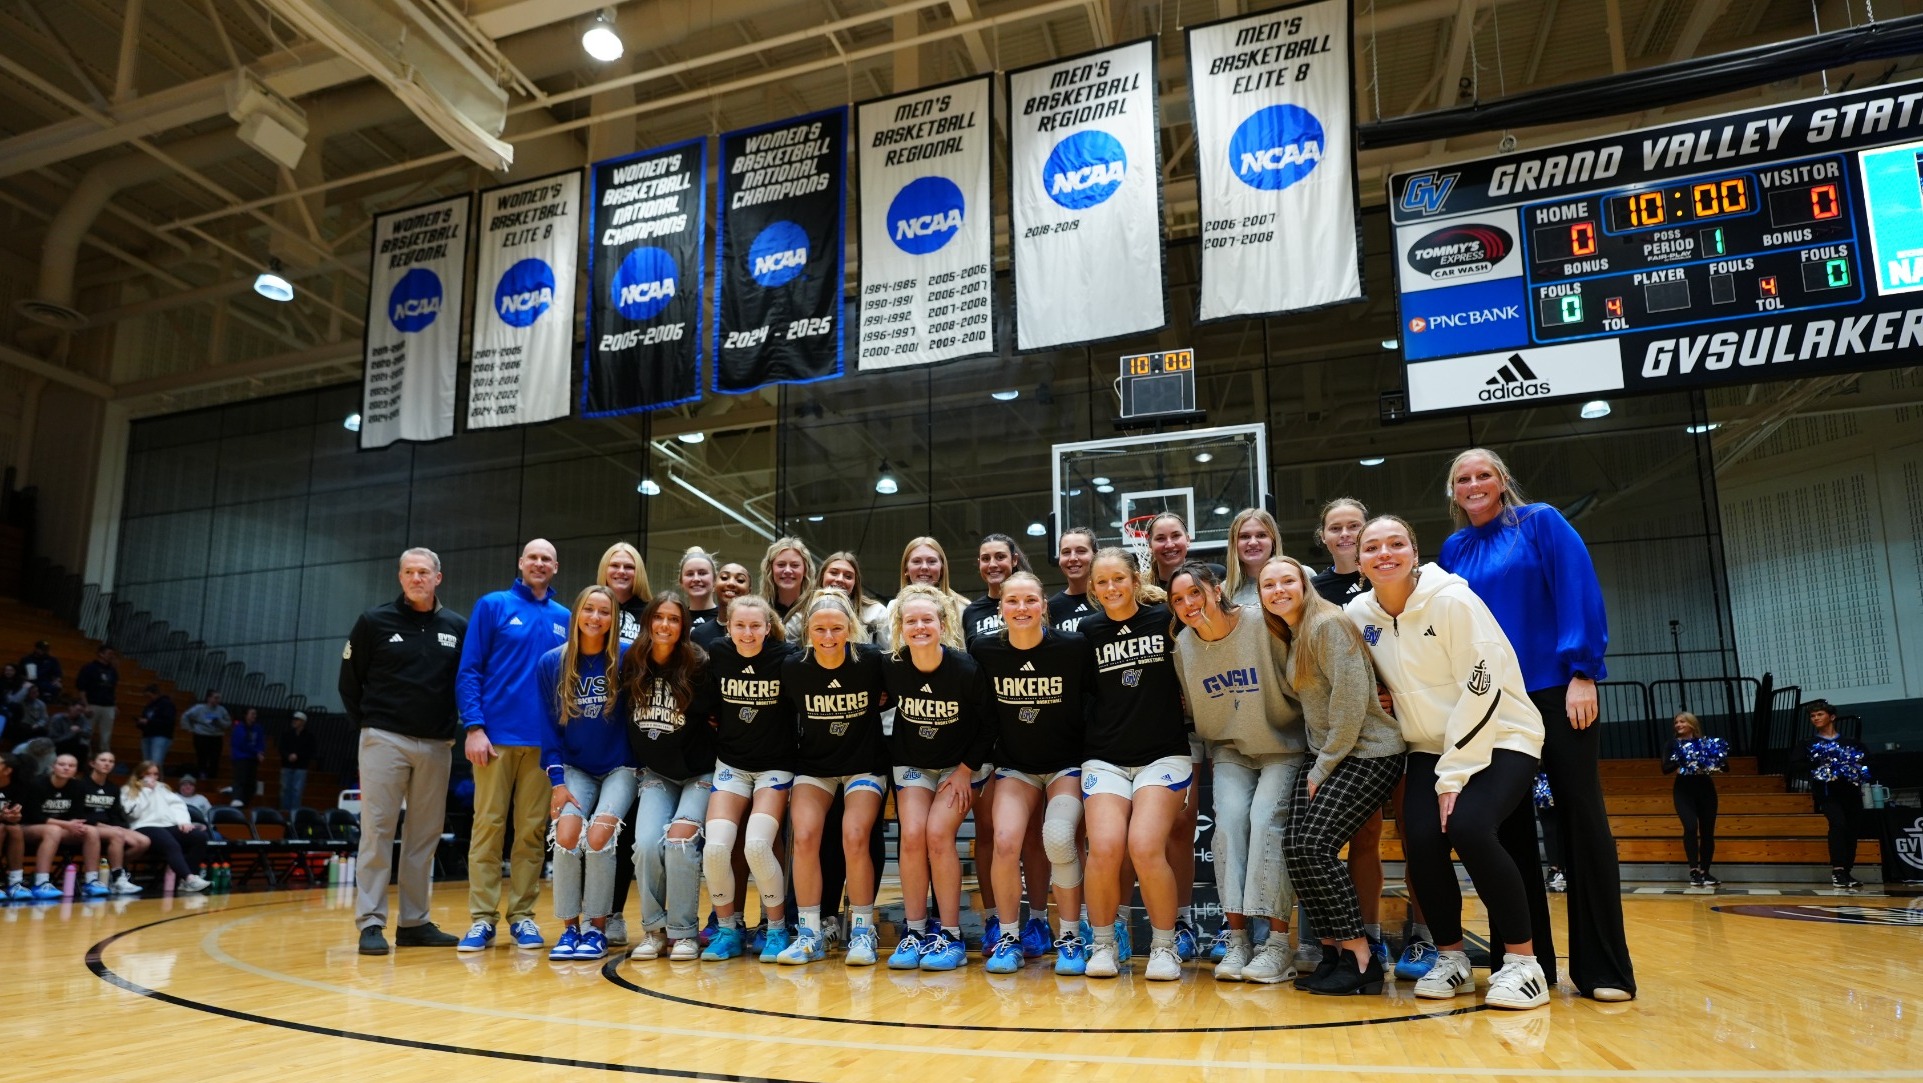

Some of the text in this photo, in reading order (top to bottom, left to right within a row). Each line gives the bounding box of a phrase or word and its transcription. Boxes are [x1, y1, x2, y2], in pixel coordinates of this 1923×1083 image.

[1235, 16, 1303, 47] MEN'S
[1209, 34, 1331, 76] BASKETBALL
[1050, 60, 1111, 90] MEN'S
[1232, 62, 1310, 96] ELITE 8
[1023, 72, 1140, 116] BASKETBALL
[894, 95, 951, 124] MEN'S
[1037, 97, 1127, 132] REGIONAL
[745, 122, 822, 153] WOMEN'S
[872, 111, 976, 148] BASKETBALL
[731, 137, 830, 175] BASKETBALL
[885, 135, 964, 168] REGIONAL
[1240, 139, 1321, 176] NCAA
[1487, 93, 1923, 197] GRAND VALLEY STAT
[613, 153, 682, 185] WOMEN'S
[742, 158, 818, 190] NATIONAL
[1052, 160, 1125, 195] NCAA
[1759, 161, 1840, 188] VISITOR
[498, 183, 562, 211] WOMEN'S
[602, 172, 691, 207] BASKETBALL
[731, 172, 830, 210] CHAMPIONS
[1400, 171, 1461, 216] GV
[1810, 184, 1838, 219] 0
[393, 208, 452, 234] WOMEN'S
[490, 202, 569, 231] BASKETBALL
[612, 195, 679, 225] NATIONAL
[896, 208, 964, 241] NCAA
[1204, 213, 1276, 233] 2006-2007
[1536, 202, 1588, 224] HOME
[381, 224, 459, 254] BASKETBALL
[502, 224, 554, 248] ELITE 8
[602, 214, 688, 247] CHAMPIONS
[1025, 219, 1080, 239] 2018-2019
[1204, 230, 1275, 250] 2007-2008
[1570, 222, 1595, 257] 0
[1653, 229, 1681, 242] POSS
[1715, 228, 1725, 254] 1
[1762, 228, 1813, 247] BONUS
[390, 243, 448, 269] REGIONAL
[1415, 240, 1480, 260] TOMMY'S
[1440, 250, 1485, 266] EXPRESS
[1643, 237, 1695, 256] PERIOD
[1801, 244, 1848, 262] FOULS
[754, 247, 807, 276] NCAA
[1434, 263, 1488, 279] CAR WASH
[1564, 258, 1609, 276] BONUS
[1709, 258, 1755, 276] FOULS
[1826, 258, 1848, 288] 0
[864, 264, 988, 295] 1984-1985 2005-2006
[1540, 282, 1582, 299] FOULS
[1633, 268, 1686, 286] PLAYER
[1761, 277, 1776, 295] 4
[394, 294, 442, 320] NCAA
[501, 286, 555, 316] NCAA
[619, 277, 676, 308] NCAA
[864, 281, 988, 311] 1990-1991 2006-2007
[1607, 298, 1621, 316] 4
[1755, 297, 1785, 312] TOL
[864, 297, 988, 327] 1991-1992 2007-2008
[1561, 295, 1582, 324] 0
[1602, 316, 1630, 331] TOL
[600, 322, 685, 352] 2005-2006
[863, 313, 988, 343] 1996-1997 2008-2009
[862, 330, 986, 358] 2000-2001 2009-2010
[1641, 308, 1923, 379] GVSULAKER
[1478, 379, 1551, 402] adidas
[1095, 634, 1164, 665] LAKERS
[1363, 624, 1383, 646] GV
[720, 677, 781, 698] LAKERS
[993, 676, 1063, 697] LAKERS
[805, 691, 869, 713] LAKERS
[898, 695, 959, 717] LAKERS
